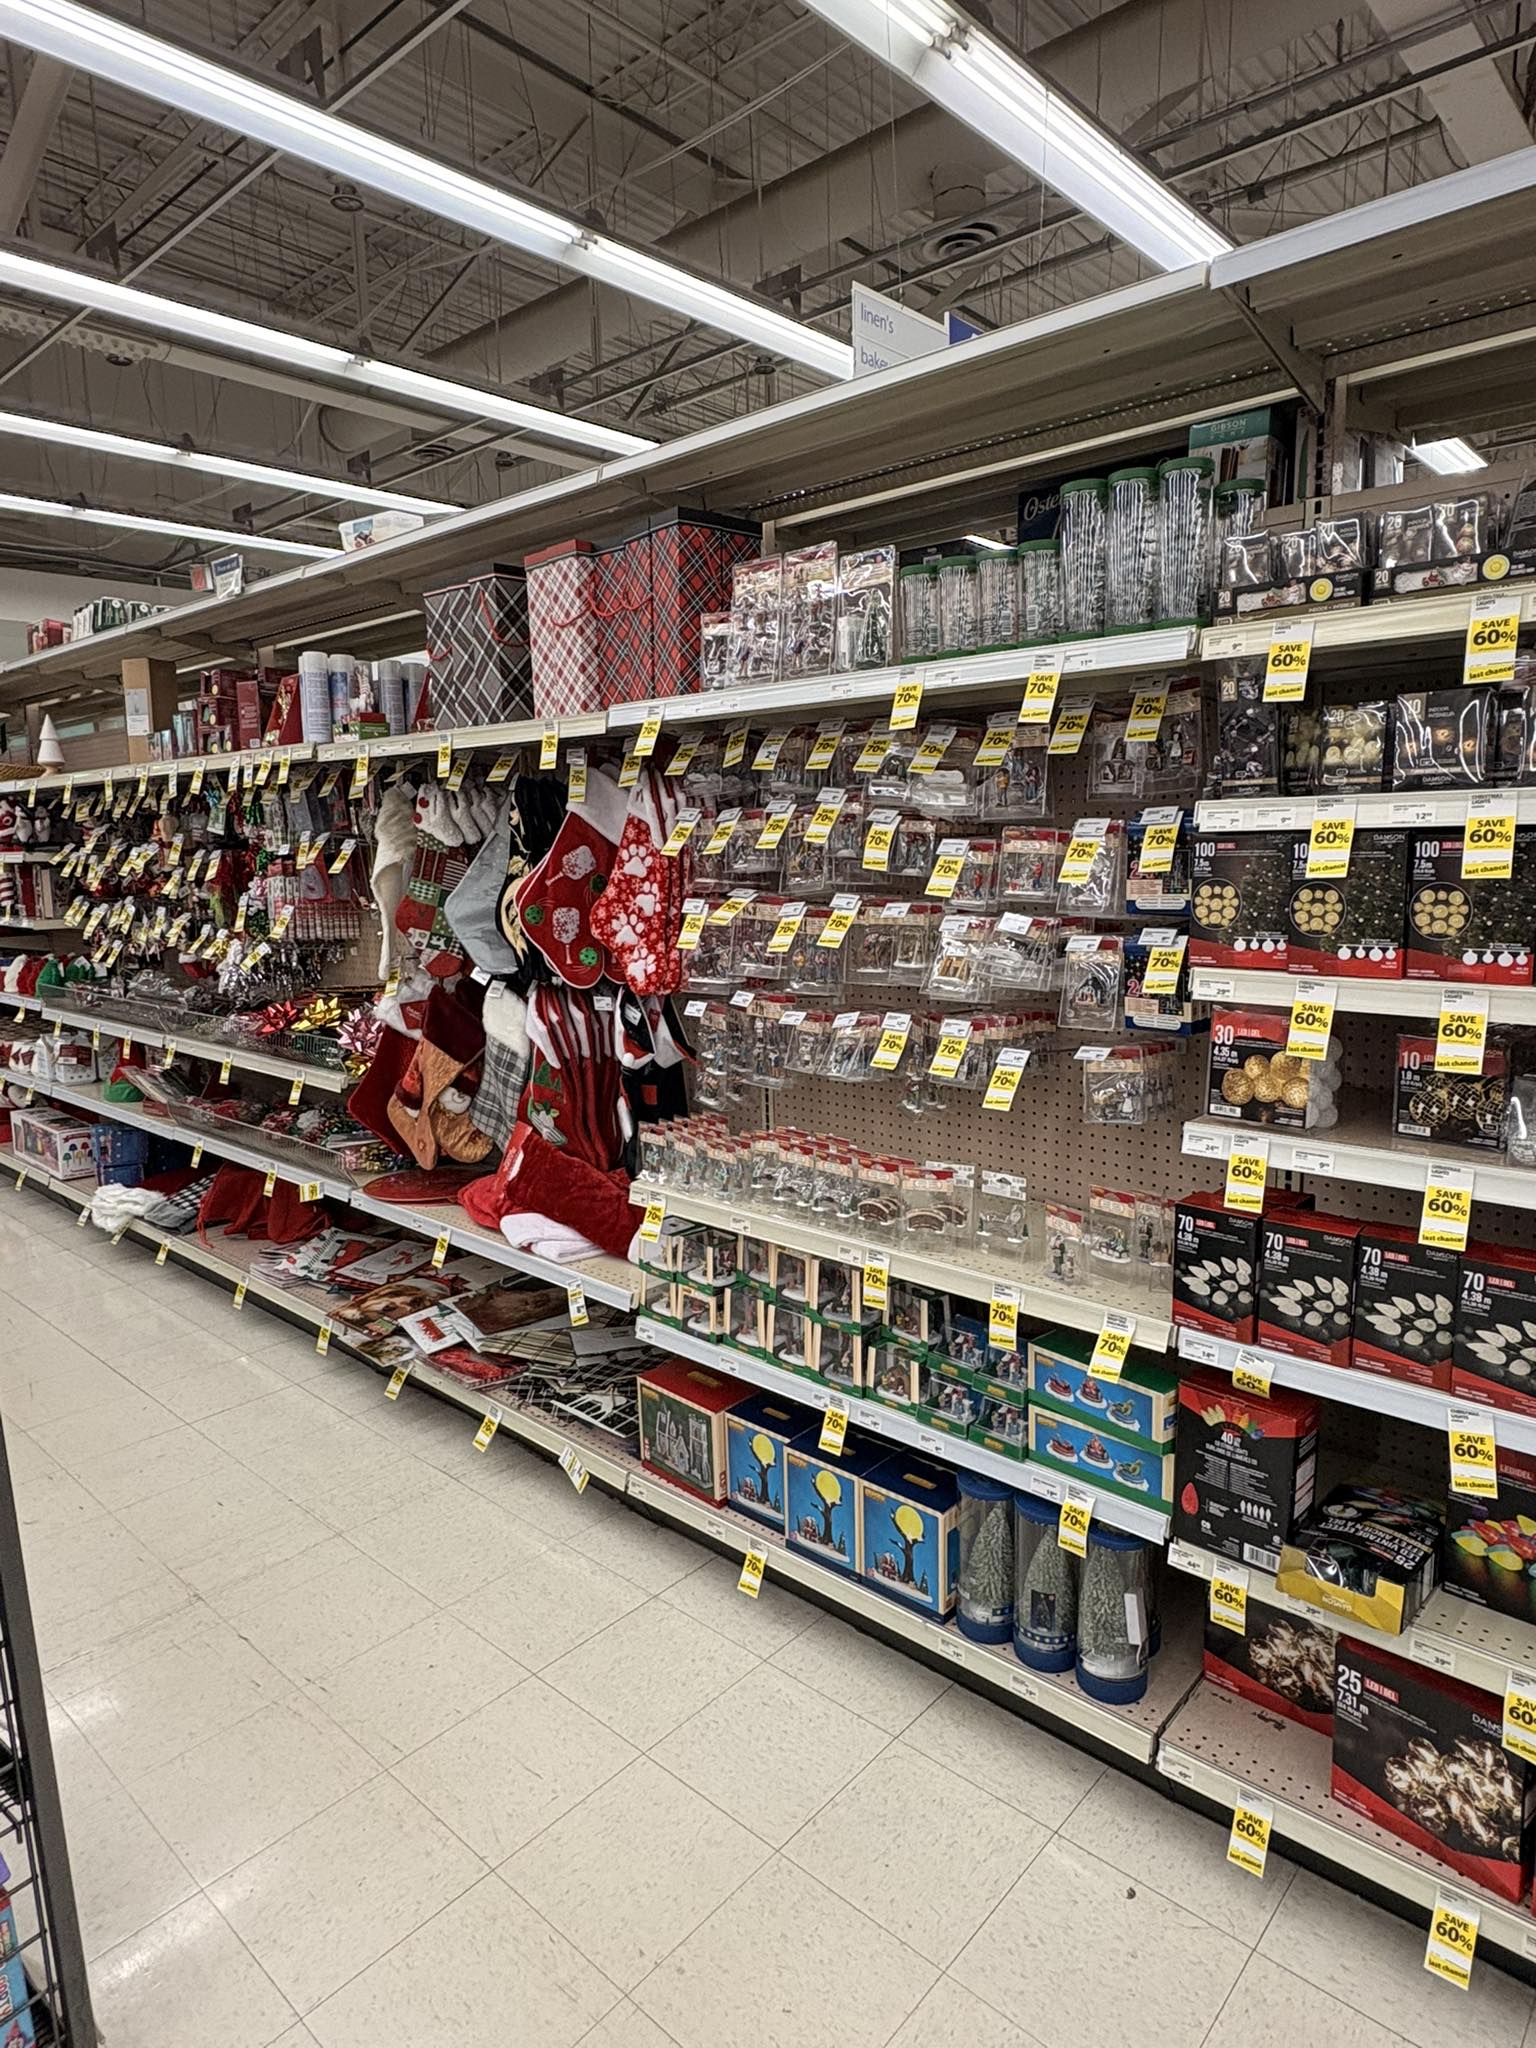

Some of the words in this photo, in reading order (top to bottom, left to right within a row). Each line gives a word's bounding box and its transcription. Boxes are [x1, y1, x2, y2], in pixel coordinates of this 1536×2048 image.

[861, 303, 895, 334] linen's
[1210, 418, 1247, 433] GIBSON
[1024, 493, 1061, 521] Oste
[1375, 570, 1389, 584] 20
[1219, 591, 1231, 603] 20
[1481, 619, 1510, 629] SAVE
[1473, 629, 1517, 646] 60%
[1278, 644, 1302, 652] SAVE
[1271, 654, 1306, 667] 60%
[1469, 671, 1483, 680] last
[1484, 665, 1514, 676] chance!
[1029, 683, 1055, 694] 70%
[1223, 682, 1236, 695] 20
[897, 693, 919, 703] 70%
[1135, 705, 1162, 715] 70%
[1331, 709, 1344, 723] 20
[642, 727, 657, 735] 70%
[1059, 721, 1084, 730] 70%
[544, 740, 555, 749] 70%
[985, 737, 1010, 746] 70%
[866, 745, 886, 753] 70%
[919, 745, 943, 754] 70%
[624, 760, 640, 768] 70%
[571, 774, 585, 782] 70%
[815, 813, 834, 822] 70%
[1477, 819, 1506, 827] SAVE
[767, 823, 783, 832] 70%
[868, 835, 888, 846] 70%
[1148, 835, 1175, 846] 70%
[1315, 832, 1349, 844] 60%
[1373, 834, 1405, 842] DAMSON
[1470, 828, 1511, 843] 60%
[1069, 848, 1094, 858] 70%
[1194, 842, 1215, 857] 100
[1293, 843, 1308, 858] 10
[1415, 841, 1440, 858] 100
[936, 865, 958, 875] 70%
[1414, 859, 1432, 869] 7.5m
[1481, 863, 1509, 873] chance!
[685, 922, 700, 930] 70%
[778, 926, 795, 934] 70%
[829, 920, 847, 929] 70%
[1151, 958, 1179, 968] 70%
[1301, 1004, 1325, 1013] SAVE
[1294, 1012, 1328, 1028] 60%
[1449, 1015, 1476, 1024] SAVE
[888, 1033, 902, 1041] SAVE
[1215, 1025, 1234, 1045] 30
[1442, 1024, 1482, 1039] 60%
[882, 1040, 902, 1051] 70%
[947, 1038, 962, 1046] SAVE
[941, 1044, 962, 1055] 70%
[1213, 1046, 1230, 1058] 4.35
[1402, 1051, 1420, 1070] 10
[993, 1076, 1015, 1087] 70%
[1238, 1157, 1260, 1166] SAVE
[1232, 1166, 1264, 1181] 60%
[1436, 1189, 1463, 1200] SAVE
[1428, 1199, 1467, 1216] 60%
[647, 1211, 661, 1221] 70%
[1178, 1214, 1194, 1232] 70
[1265, 1232, 1283, 1250] 70
[1362, 1246, 1381, 1266] 70
[869, 1267, 883, 1276] SAVE
[865, 1273, 885, 1286] 70%
[1463, 1270, 1484, 1291] 70
[1461, 1290, 1482, 1303] 4.38
[996, 1302, 1012, 1311] SAVE
[991, 1309, 1015, 1324] 70%
[1107, 1333, 1125, 1343] SAVE
[1100, 1339, 1126, 1355] 70%
[1242, 1372, 1263, 1386] SAVE
[826, 1416, 845, 1433] 70%
[1221, 1431, 1233, 1445] 40
[1459, 1435, 1486, 1445] SAVE
[1454, 1444, 1493, 1461] 60%
[1455, 1480, 1469, 1488] last
[1068, 1503, 1085, 1519] SAVE
[1063, 1510, 1087, 1532] 70%
[1355, 1529, 1399, 1552] VINTAGE
[746, 1559, 762, 1575] 70%
[1394, 1555, 1417, 1571] 25
[1219, 1582, 1240, 1596] SAVE
[1215, 1590, 1244, 1609] 60%
[1338, 1664, 1361, 1695] 25
[1516, 1698, 1536, 1712] SAV
[1509, 1706, 1536, 1725] 60
[1472, 1713, 1502, 1733] DAMS
[1243, 1811, 1264, 1827] SAVE
[1236, 1819, 1266, 1845] 60%
[1444, 1913, 1470, 1933] SAVE
[1436, 1921, 1472, 1951] 60%
